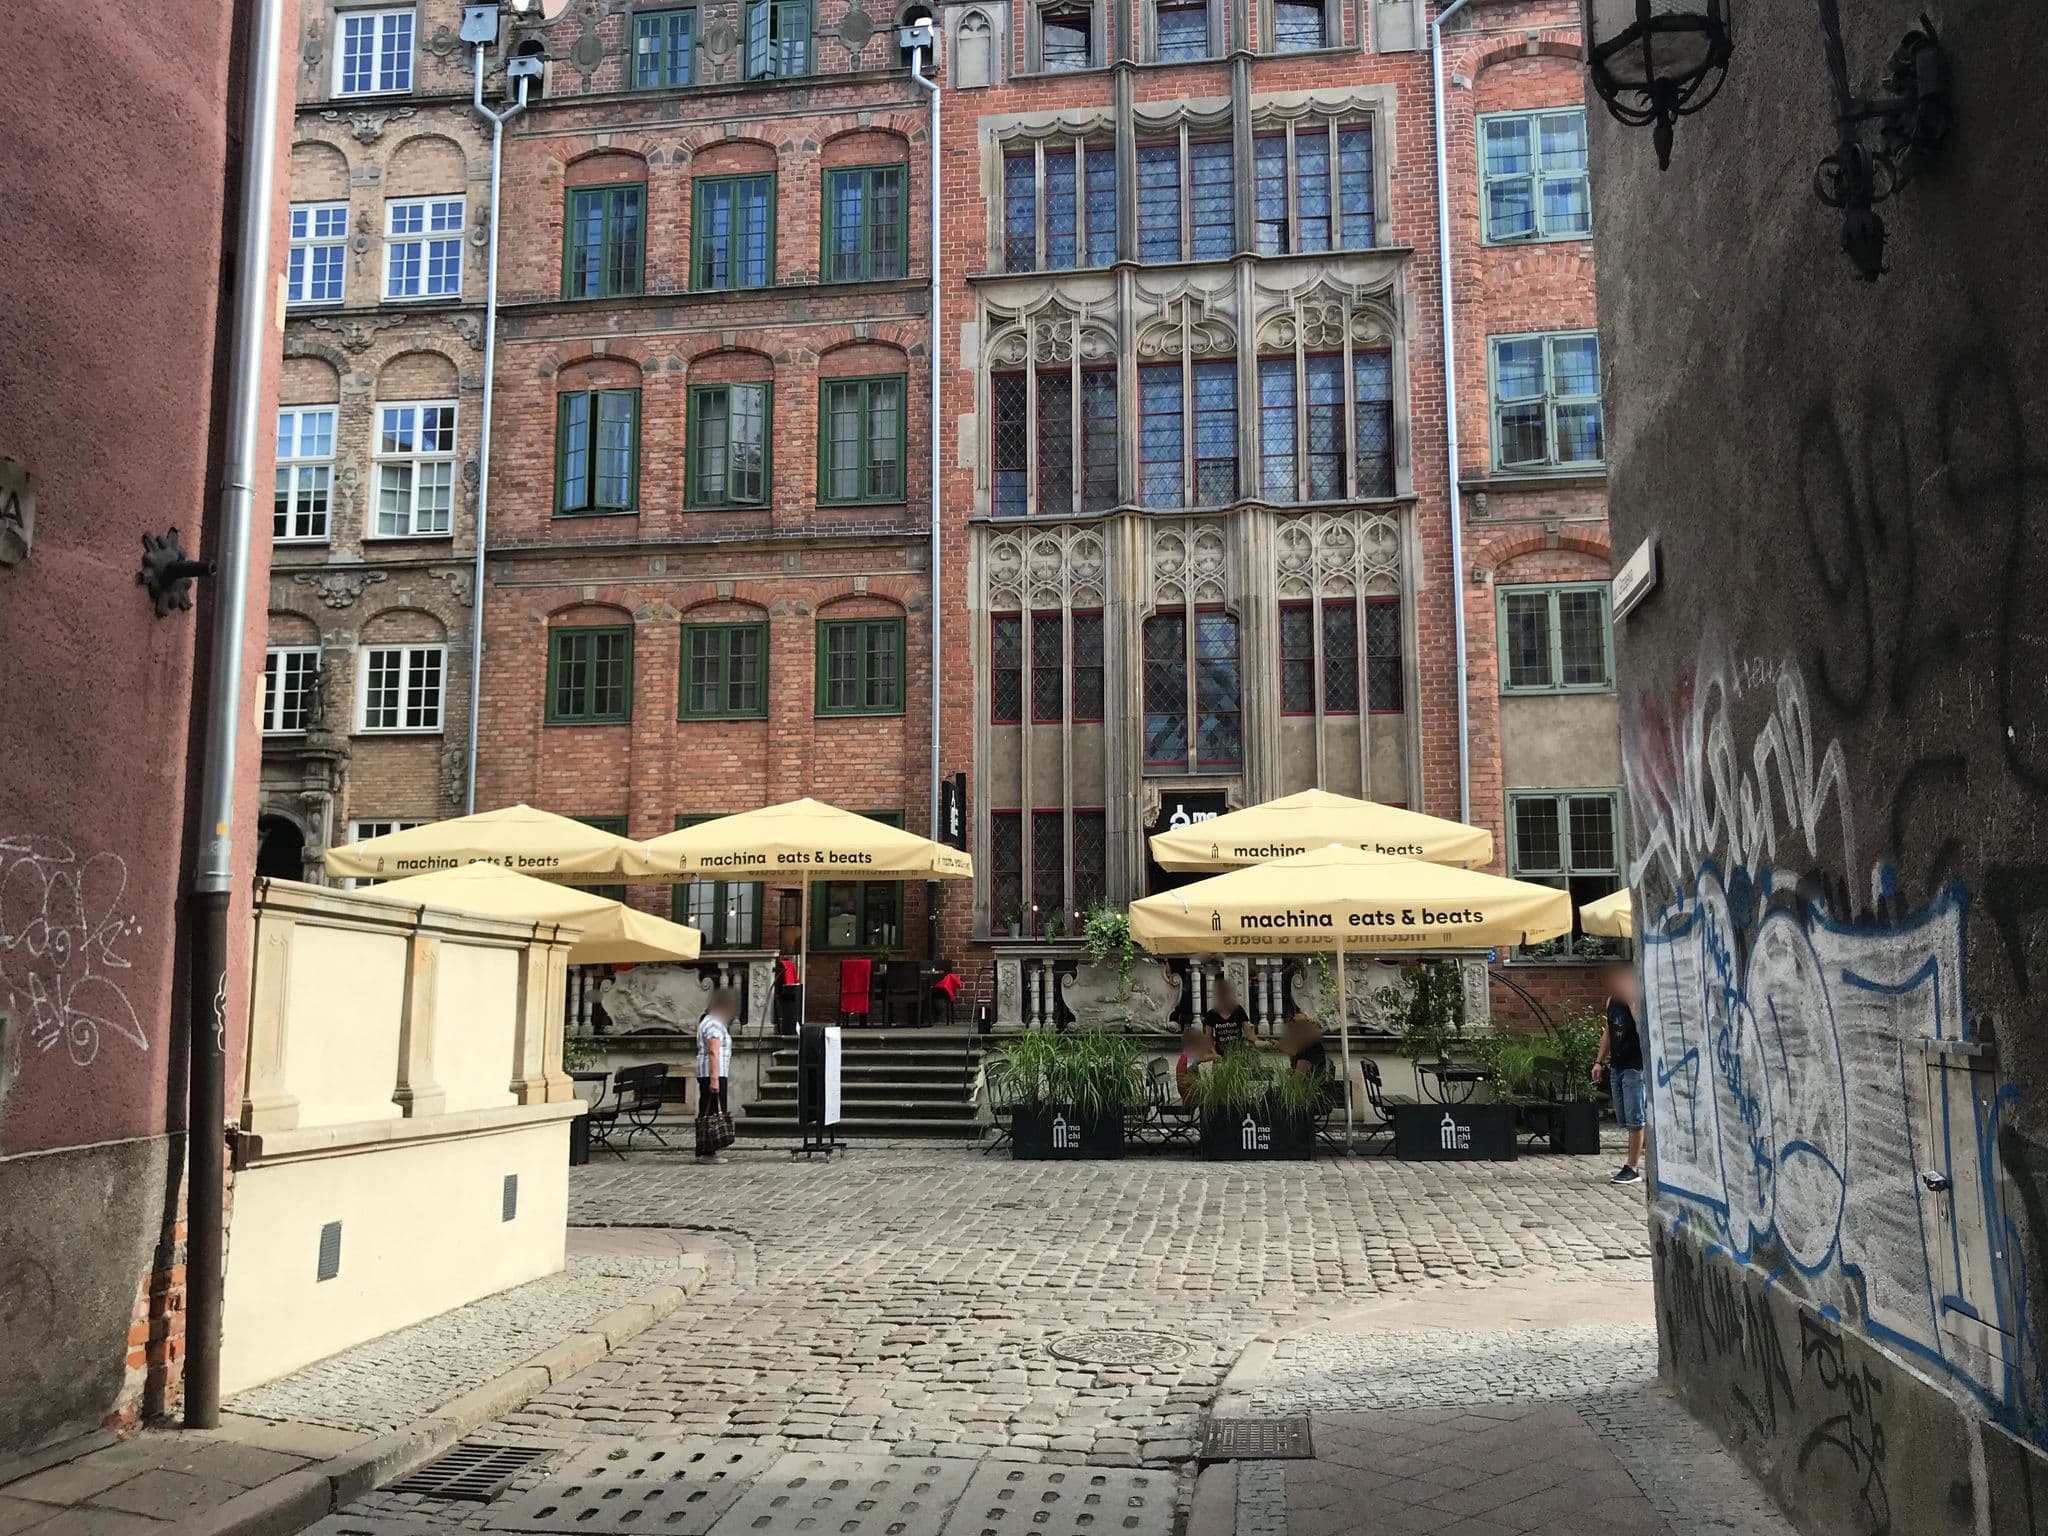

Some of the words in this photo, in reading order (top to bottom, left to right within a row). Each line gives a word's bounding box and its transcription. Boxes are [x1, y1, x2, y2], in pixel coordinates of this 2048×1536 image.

[1234, 844, 1305, 857] machina
[397, 856, 458, 870] machina
[504, 855, 513, 867] &
[518, 856, 560, 867] beats
[700, 852, 766, 866] machina
[777, 853, 810, 864] eats
[814, 851, 824, 863] &
[829, 851, 872, 864] beats
[1240, 910, 1333, 928] machina
[1349, 911, 1395, 926] eats
[1401, 910, 1416, 925] &
[1422, 908, 1484, 924] beats
